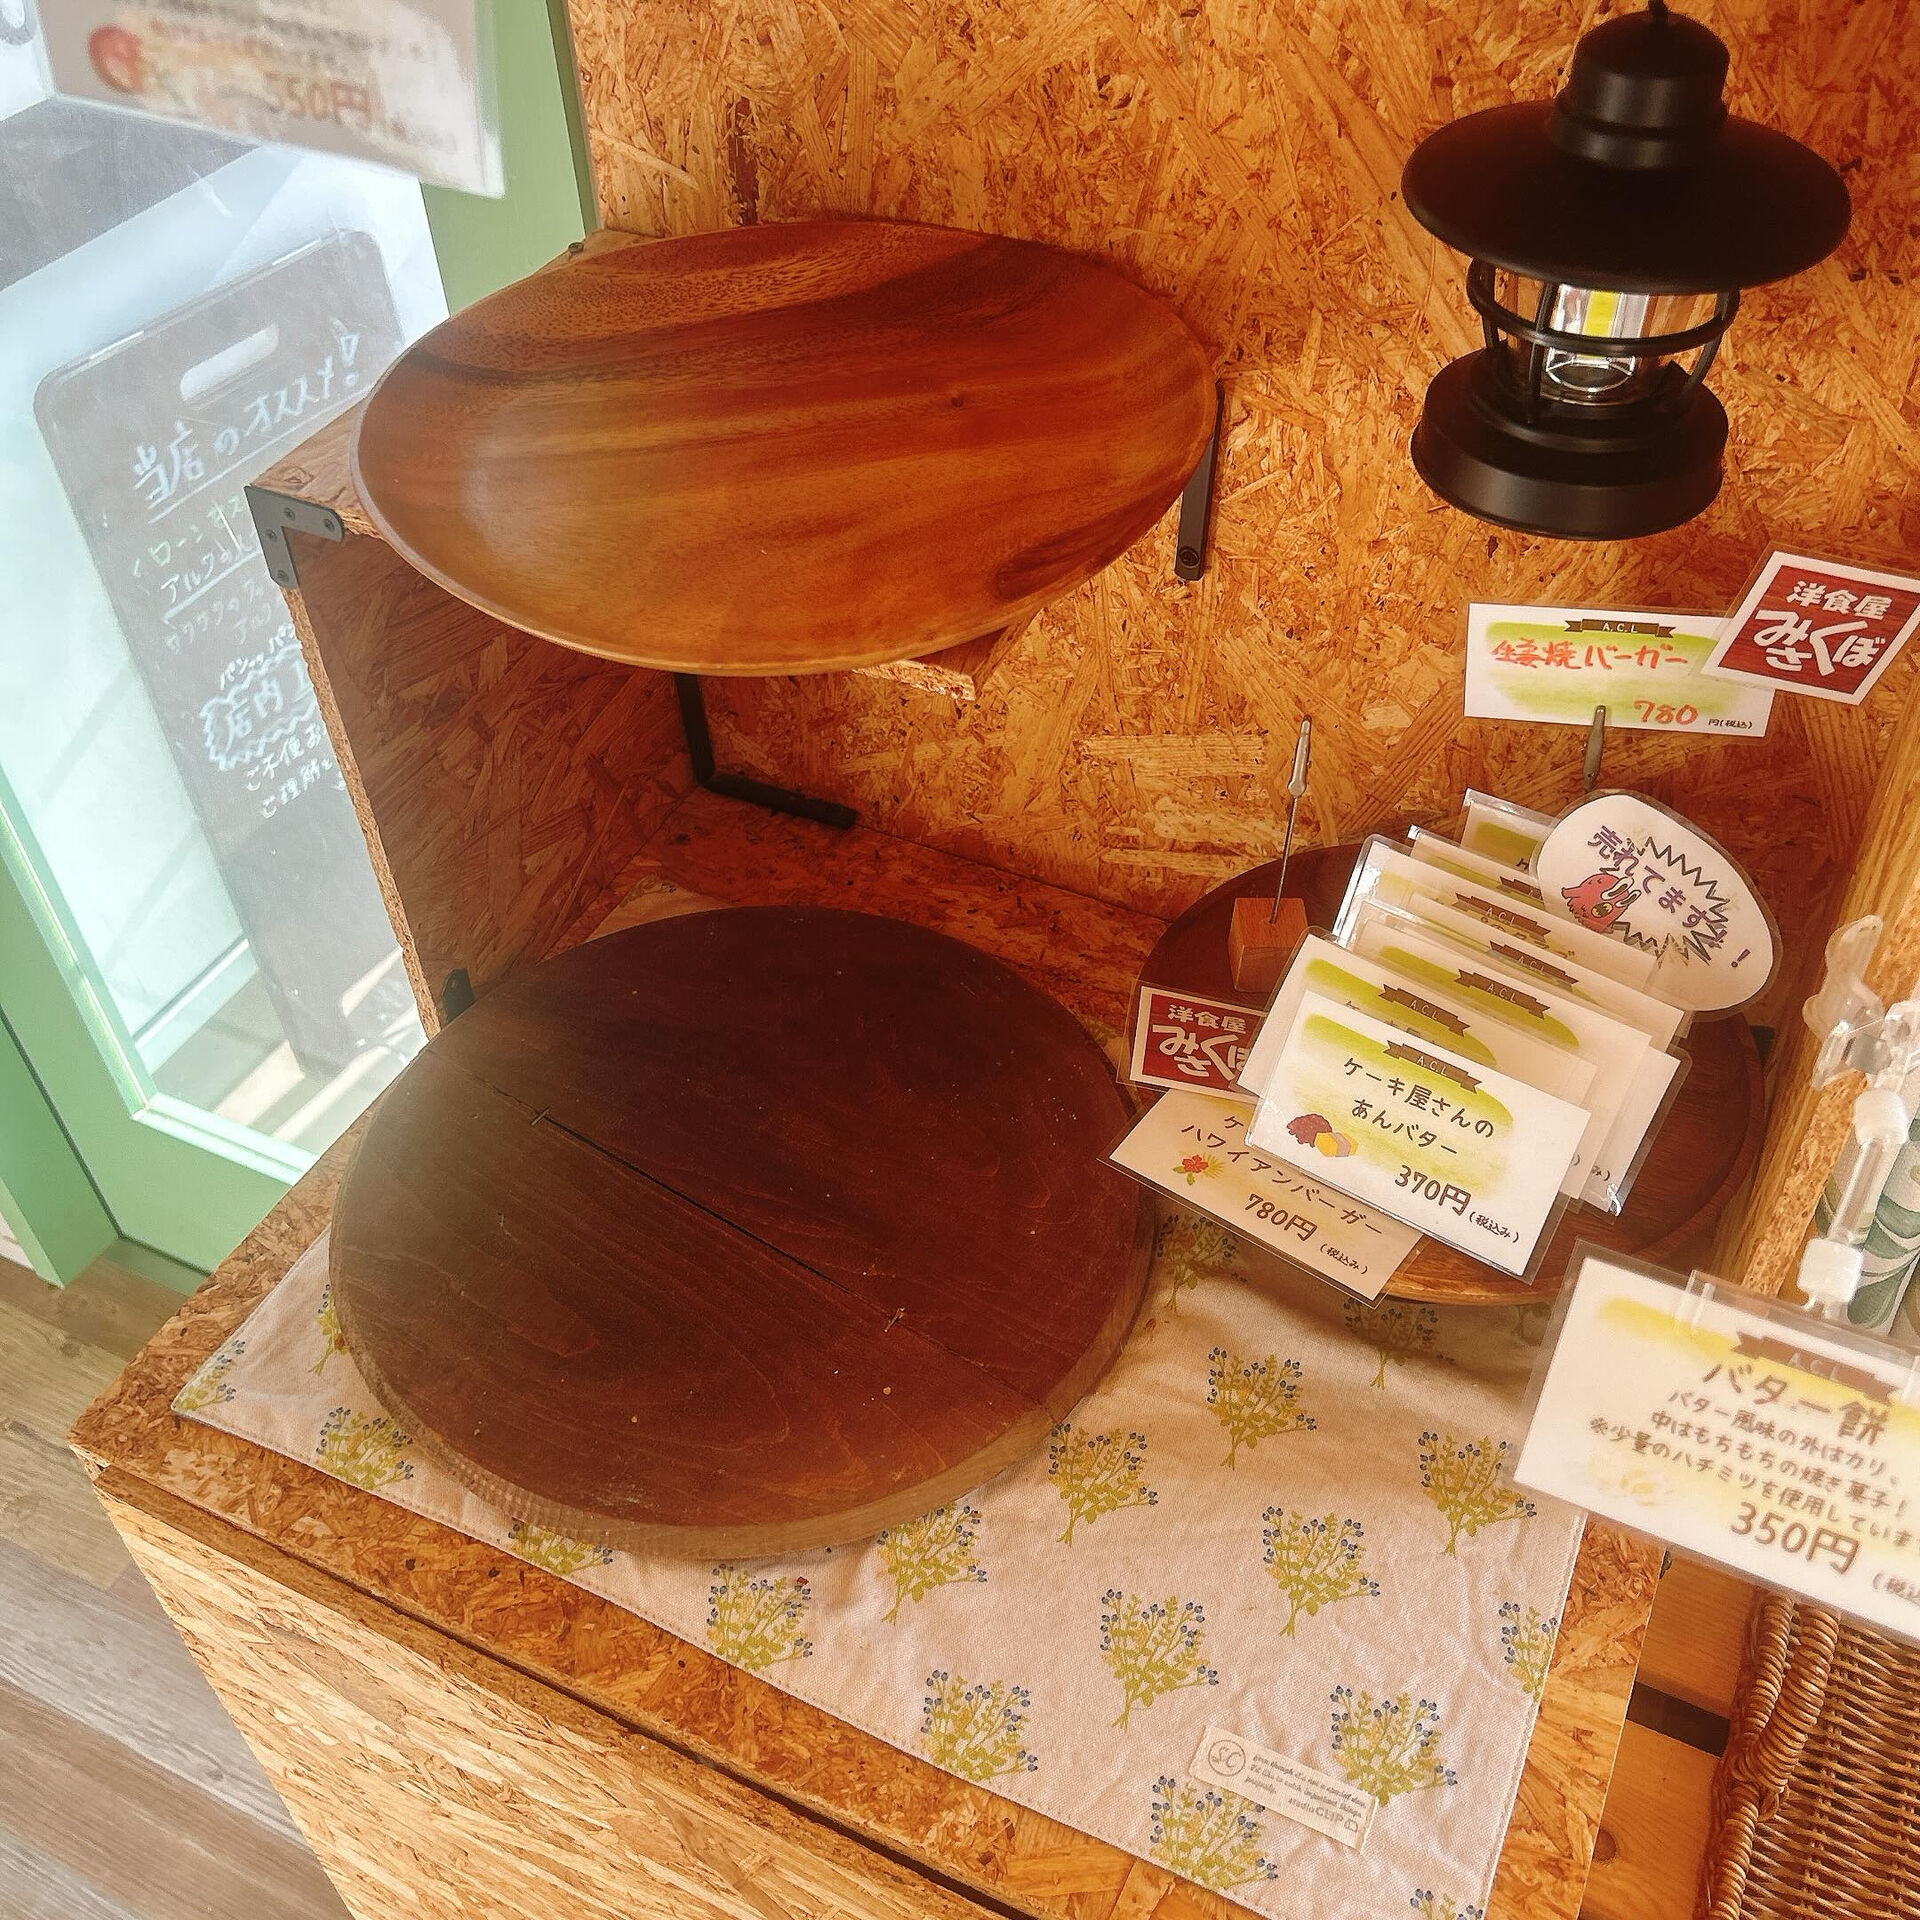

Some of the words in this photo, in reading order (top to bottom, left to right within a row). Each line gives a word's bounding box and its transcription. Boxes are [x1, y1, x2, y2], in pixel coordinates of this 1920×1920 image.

[1785, 580, 1892, 620] 洋食屋
[1602, 622, 1638, 633] A.C.L
[1634, 699, 1699, 725] 780
[1167, 1004, 1246, 1034] 洋食屋
[1415, 1055, 1447, 1076] A.C.L
[1343, 1057, 1494, 1139] ケーキ屋さんの
[1351, 1098, 1458, 1155] あんバター
[1181, 1125, 1383, 1235] ハワイアンバーガー
[1394, 1164, 1472, 1217] 370円
[1244, 1193, 1318, 1241] 780円
[1702, 1363, 1889, 1446] バター餅
[1590, 1417, 1920, 1555] ※少量のハチミツを使用していま
[1730, 1501, 1861, 1575] 350円
